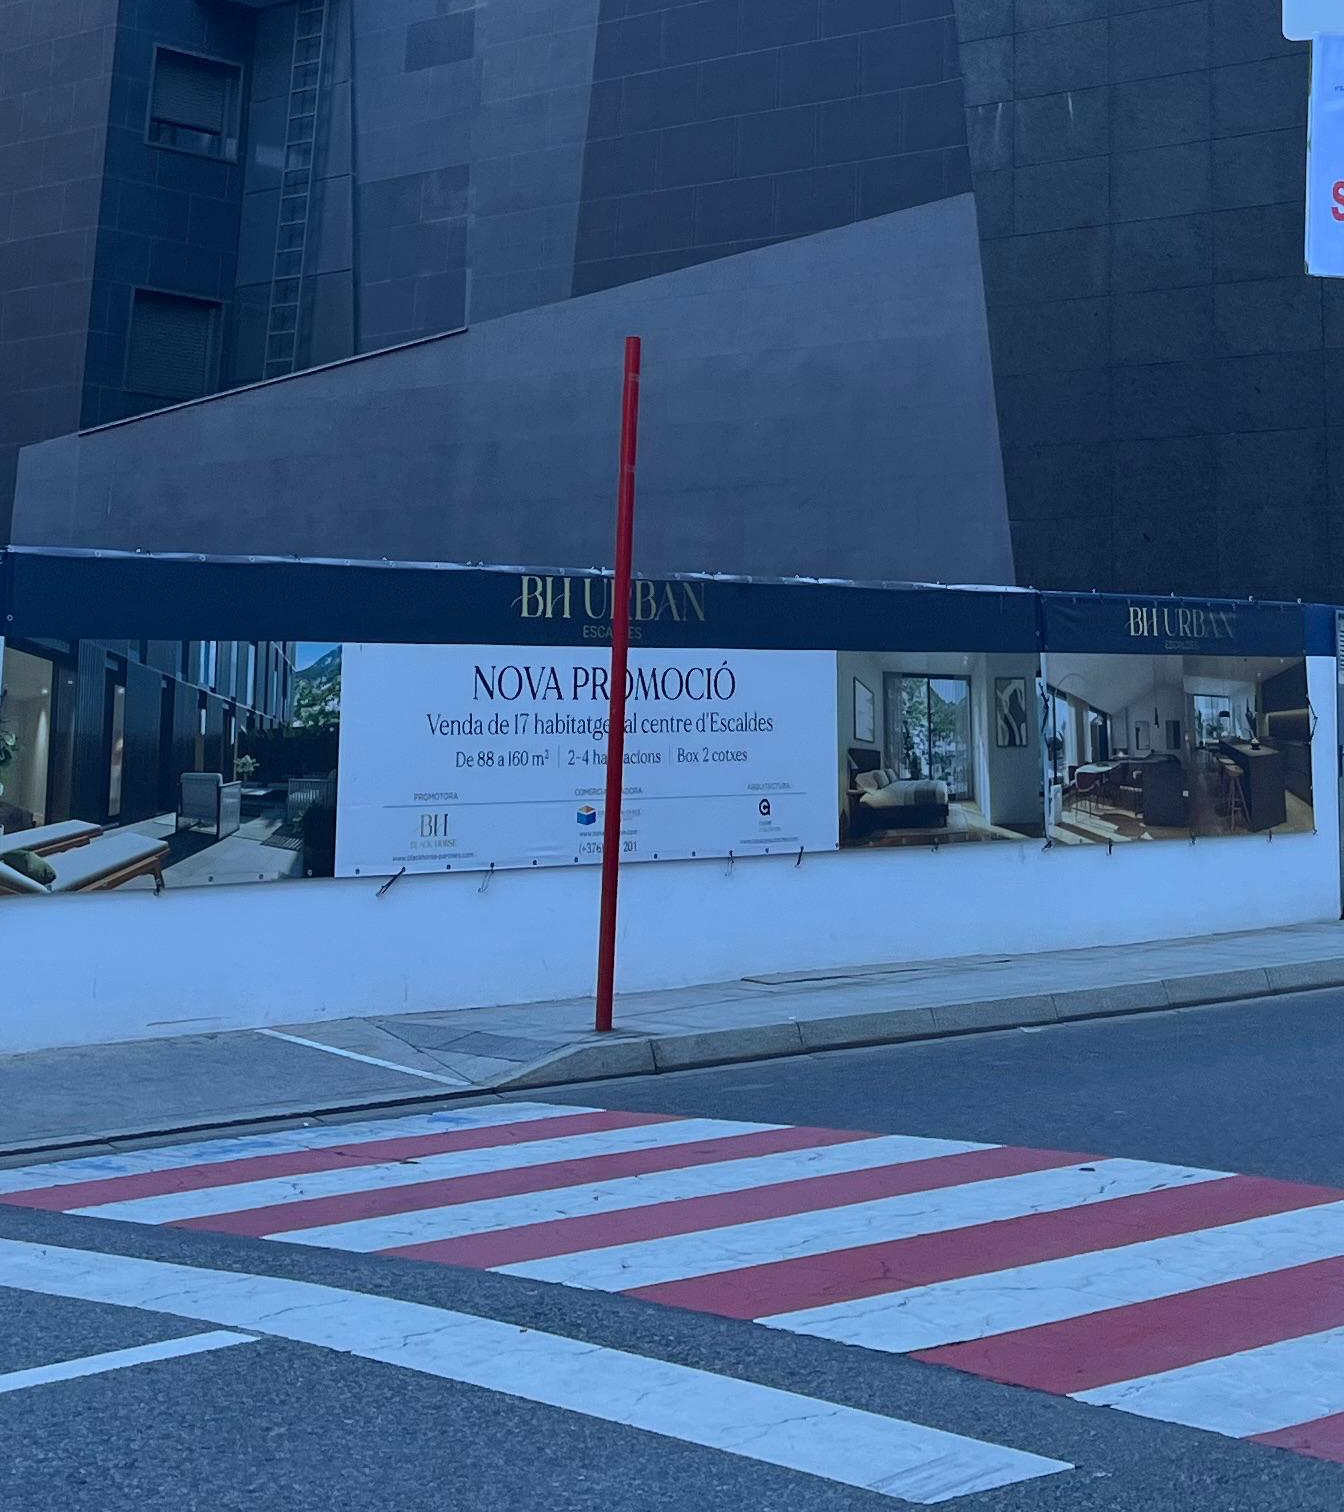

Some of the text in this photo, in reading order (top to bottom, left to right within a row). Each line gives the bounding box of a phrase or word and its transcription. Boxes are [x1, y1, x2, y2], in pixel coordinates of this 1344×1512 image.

[510, 575, 572, 619] BH
[582, 624, 643, 639] ESCAES
[1124, 607, 1159, 637] BH
[472, 665, 565, 701] NOVA
[426, 711, 774, 741] Venda de 17 habitatge al centre d'Escaldes
[455, 747, 748, 768] De 88 a 160 m² 2-4 haacions Box 2 cotxes
[419, 813, 449, 838] BH
